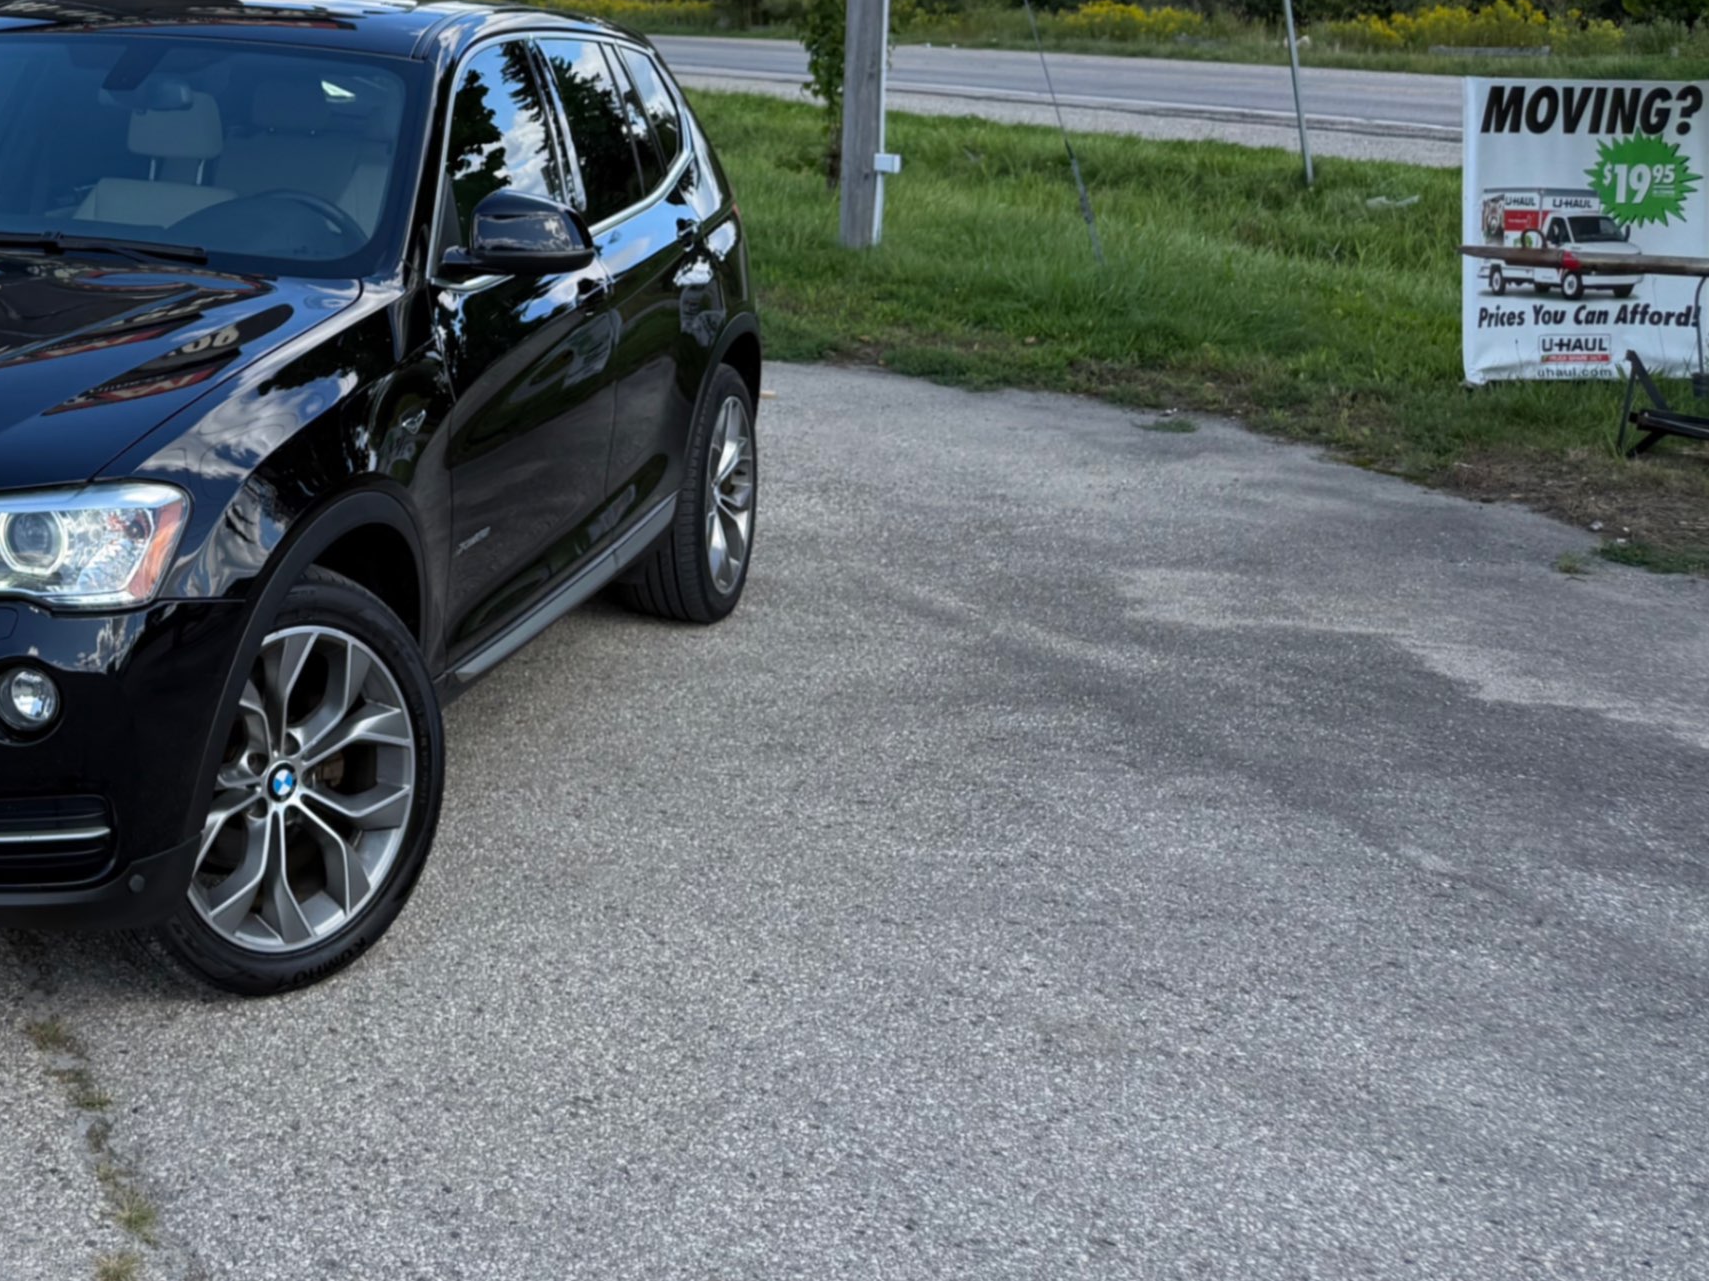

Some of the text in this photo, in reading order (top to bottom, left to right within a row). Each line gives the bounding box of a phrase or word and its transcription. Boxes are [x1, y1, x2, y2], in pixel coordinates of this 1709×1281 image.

[1480, 85, 1704, 136] MOVING?
[1478, 304, 1526, 328] Prices
[1532, 304, 1567, 326] You
[1573, 303, 1610, 326] Can
[1541, 337, 1608, 352] U-HAUL
[1537, 366, 1612, 378] uhaul.com
